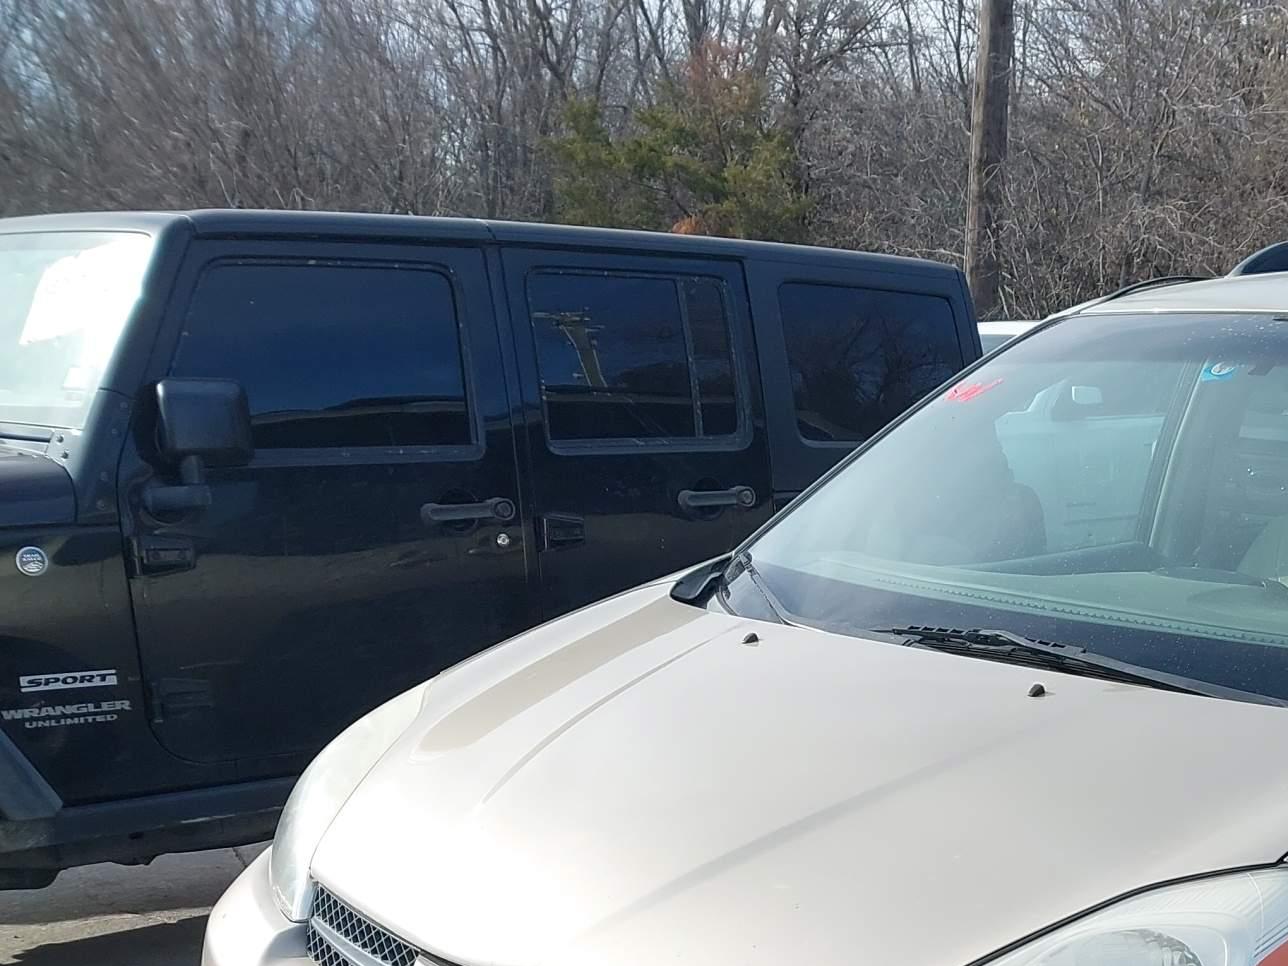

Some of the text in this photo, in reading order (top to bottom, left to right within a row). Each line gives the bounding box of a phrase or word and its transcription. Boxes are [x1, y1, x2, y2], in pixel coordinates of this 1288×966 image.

[26, 674, 112, 688] SPORT
[1, 700, 132, 720] WRANGLER
[24, 713, 118, 729] UNLIMITED
